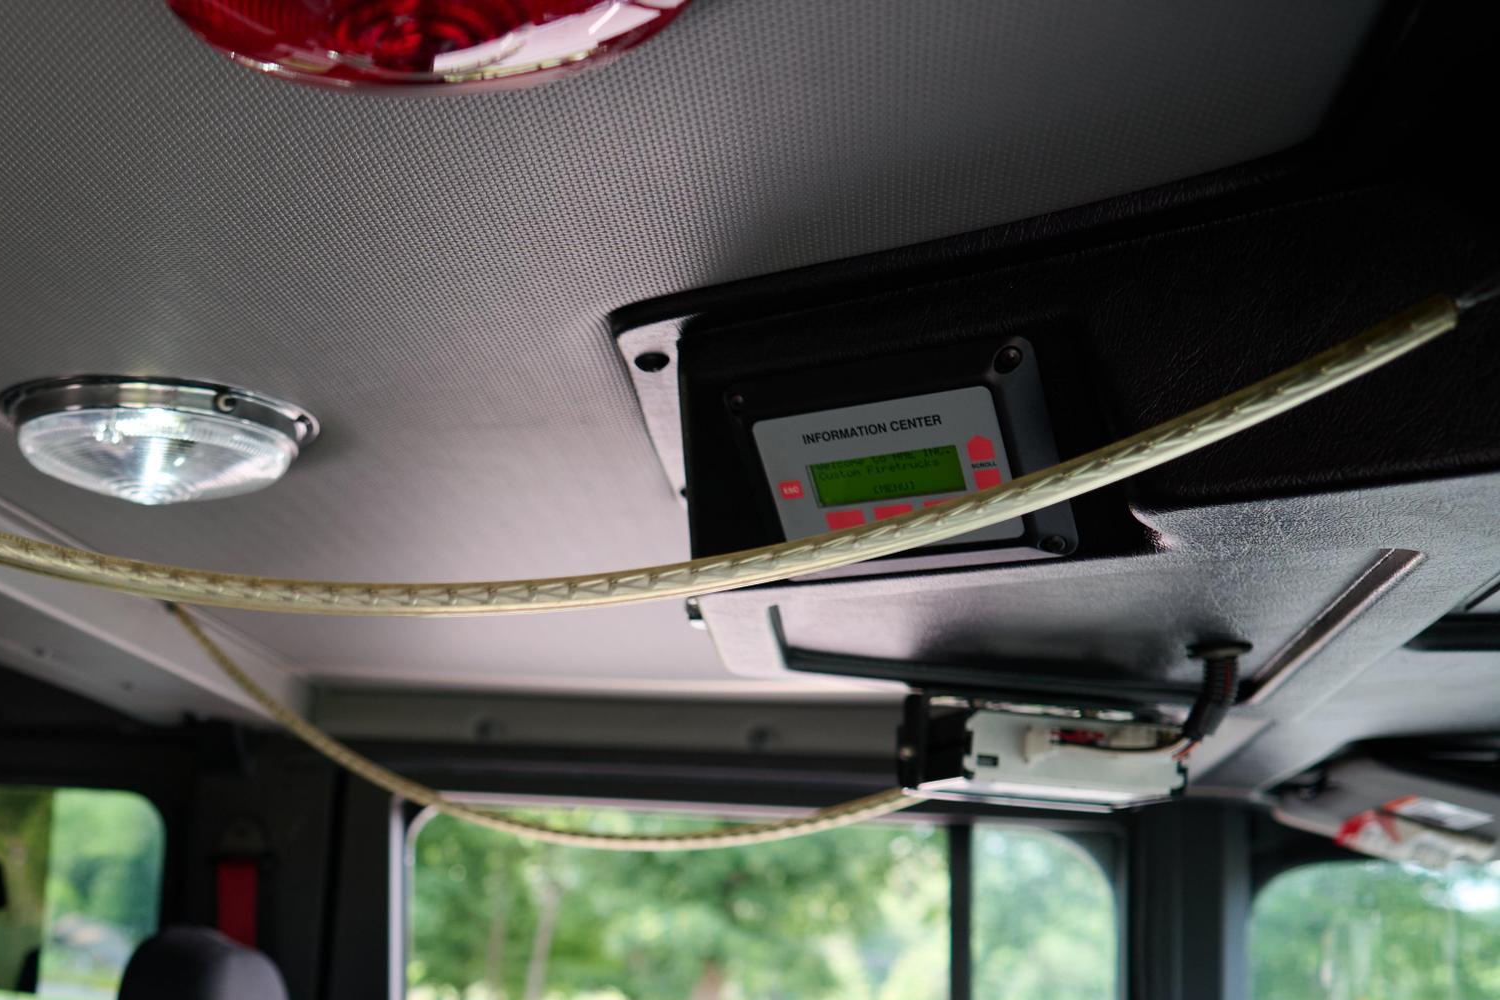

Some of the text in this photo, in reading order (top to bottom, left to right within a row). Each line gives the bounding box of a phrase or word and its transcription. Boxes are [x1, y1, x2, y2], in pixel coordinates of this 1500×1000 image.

[802, 414, 943, 445] INFORMATION CENTER
[819, 458, 940, 481] Custom Firetrucks
[971, 461, 997, 469] SCROLL
[782, 486, 800, 495] ESC
